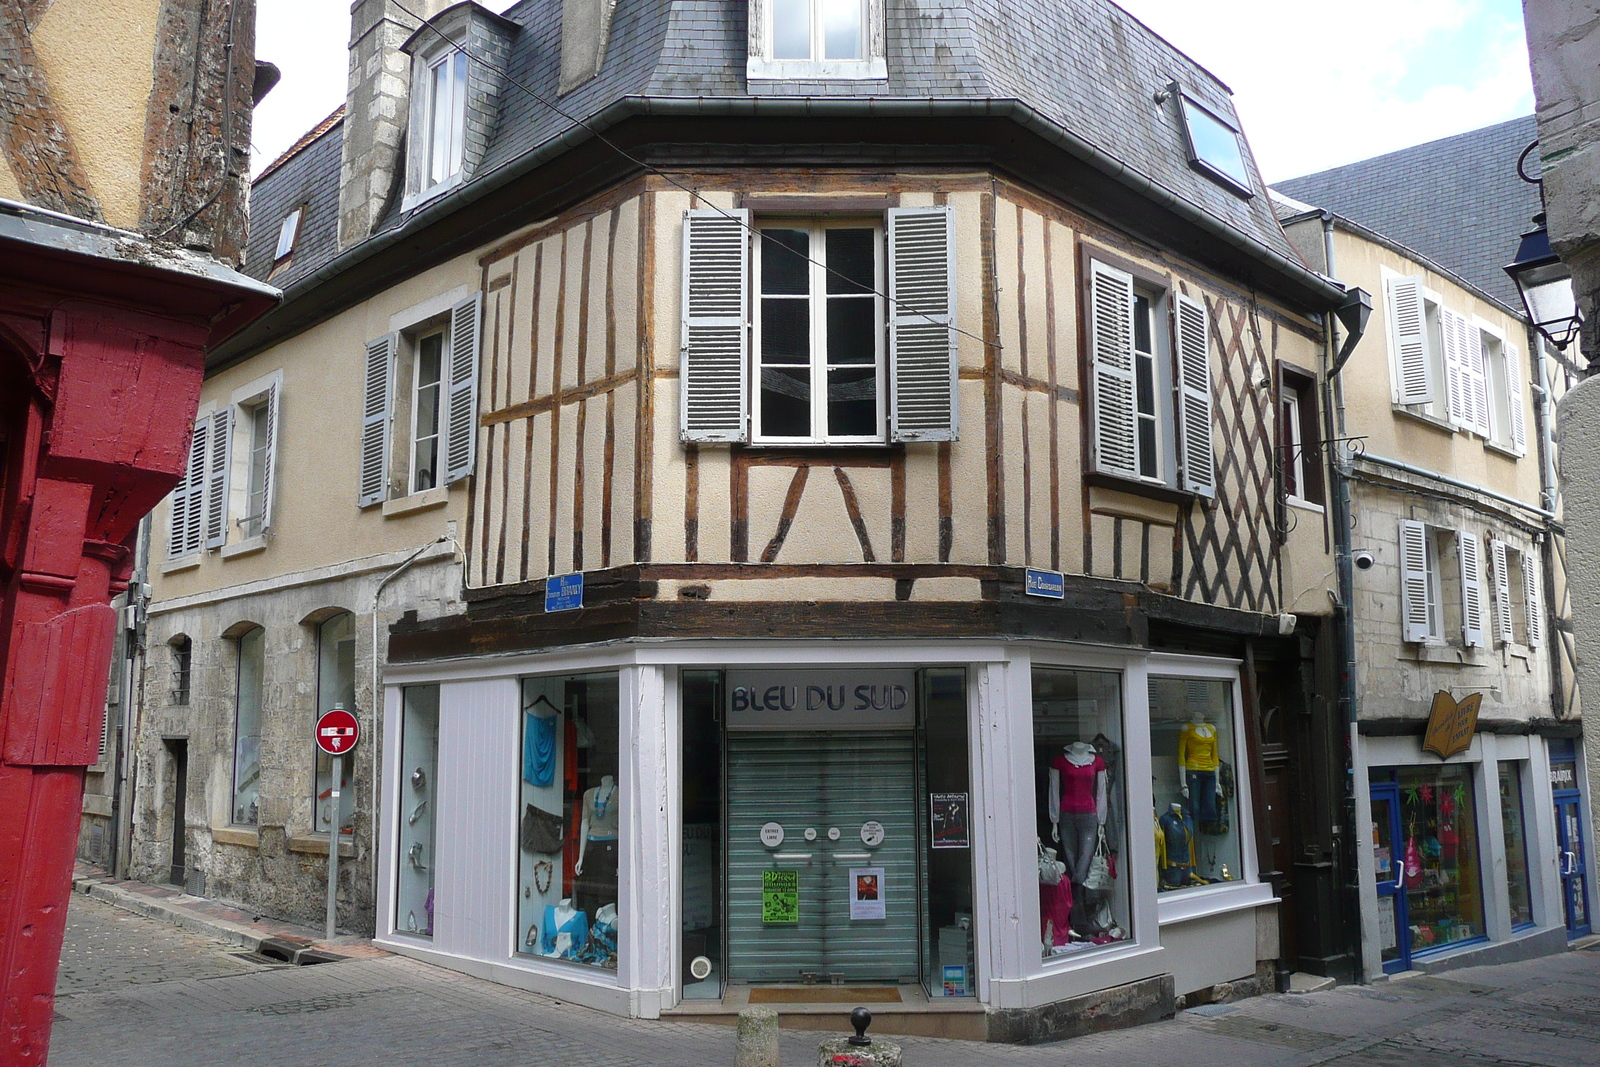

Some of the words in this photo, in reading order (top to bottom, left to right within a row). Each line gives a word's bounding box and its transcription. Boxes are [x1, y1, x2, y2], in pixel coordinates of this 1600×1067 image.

[731, 685, 798, 712] BLEU
[806, 685, 846, 711] DU
[854, 685, 909, 711] SUD
